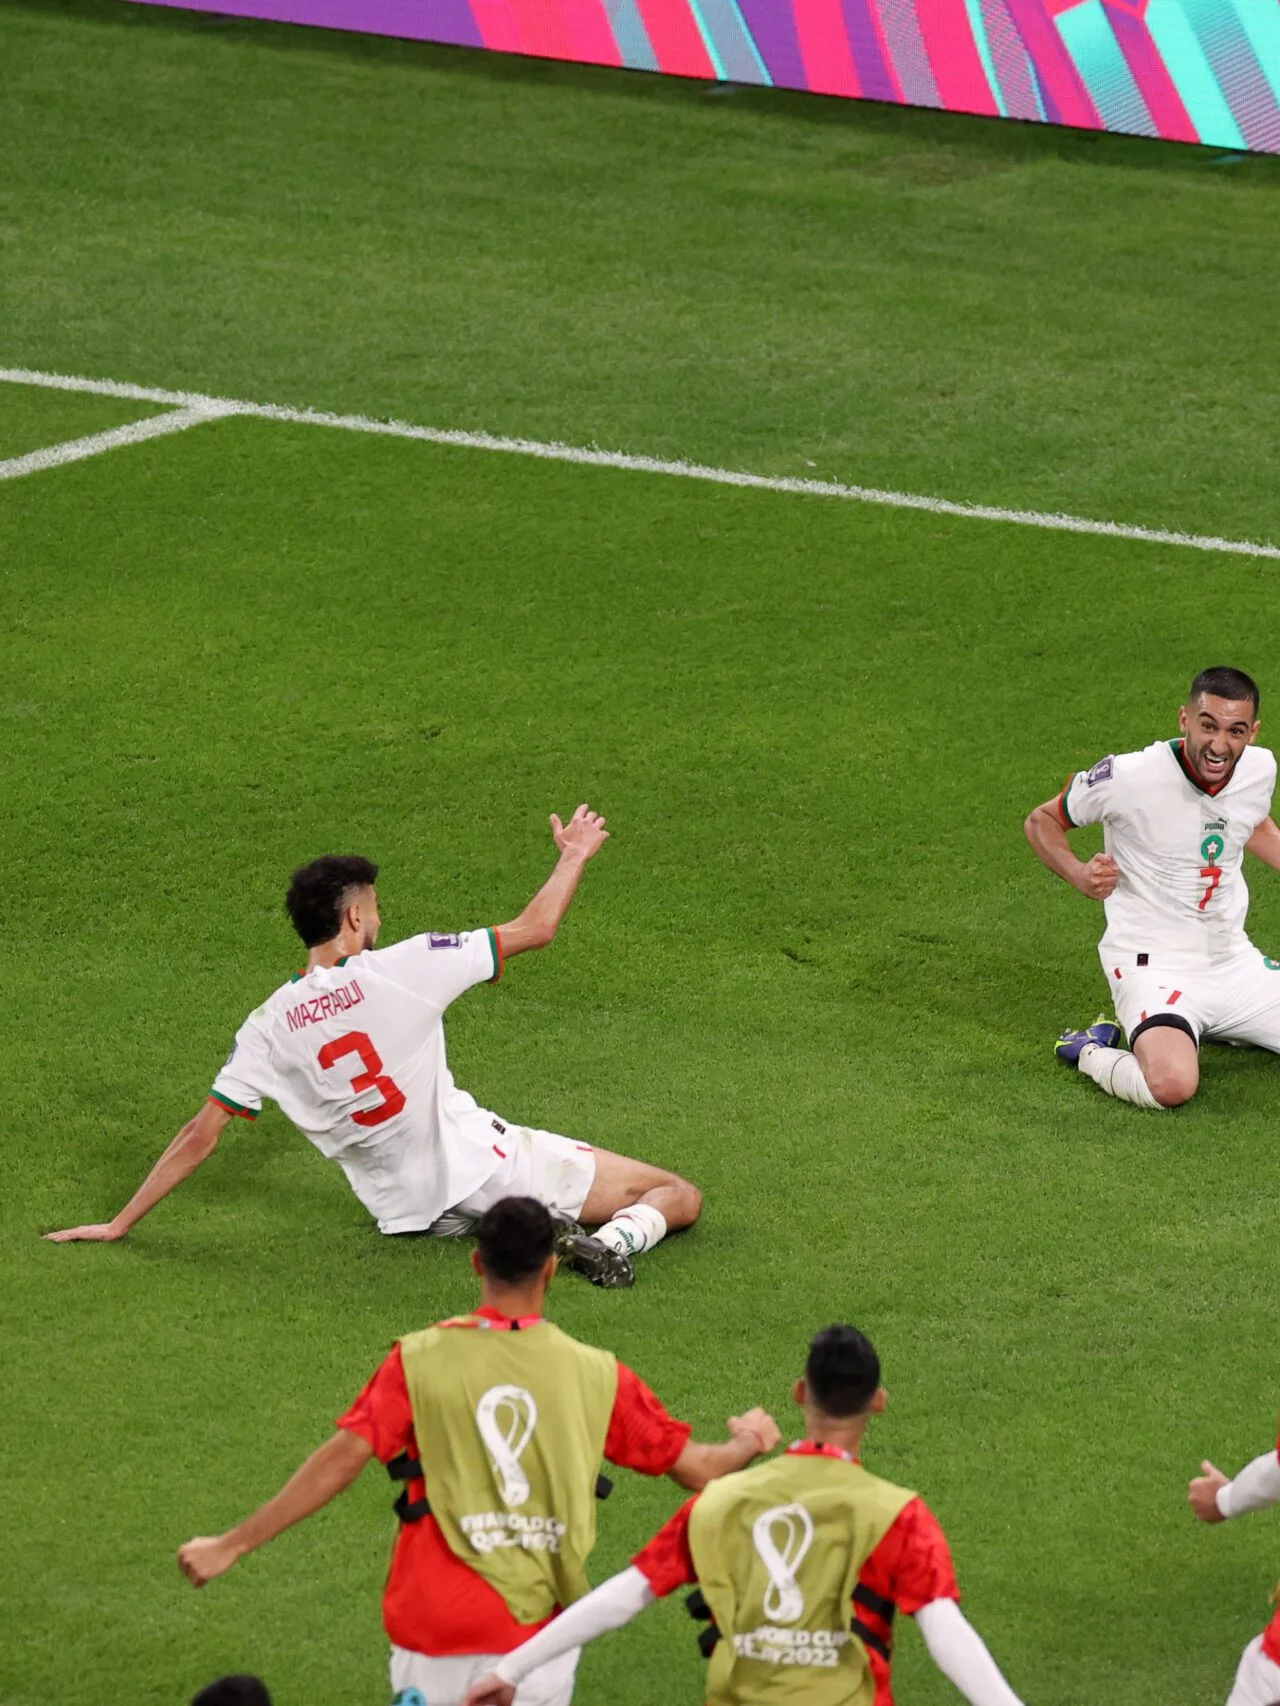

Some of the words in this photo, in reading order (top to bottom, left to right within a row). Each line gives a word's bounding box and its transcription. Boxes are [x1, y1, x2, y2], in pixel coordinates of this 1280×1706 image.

[1199, 866, 1223, 910] 7
[286, 979, 365, 1032] MAZRAOUI
[317, 1030, 407, 1127] 3
